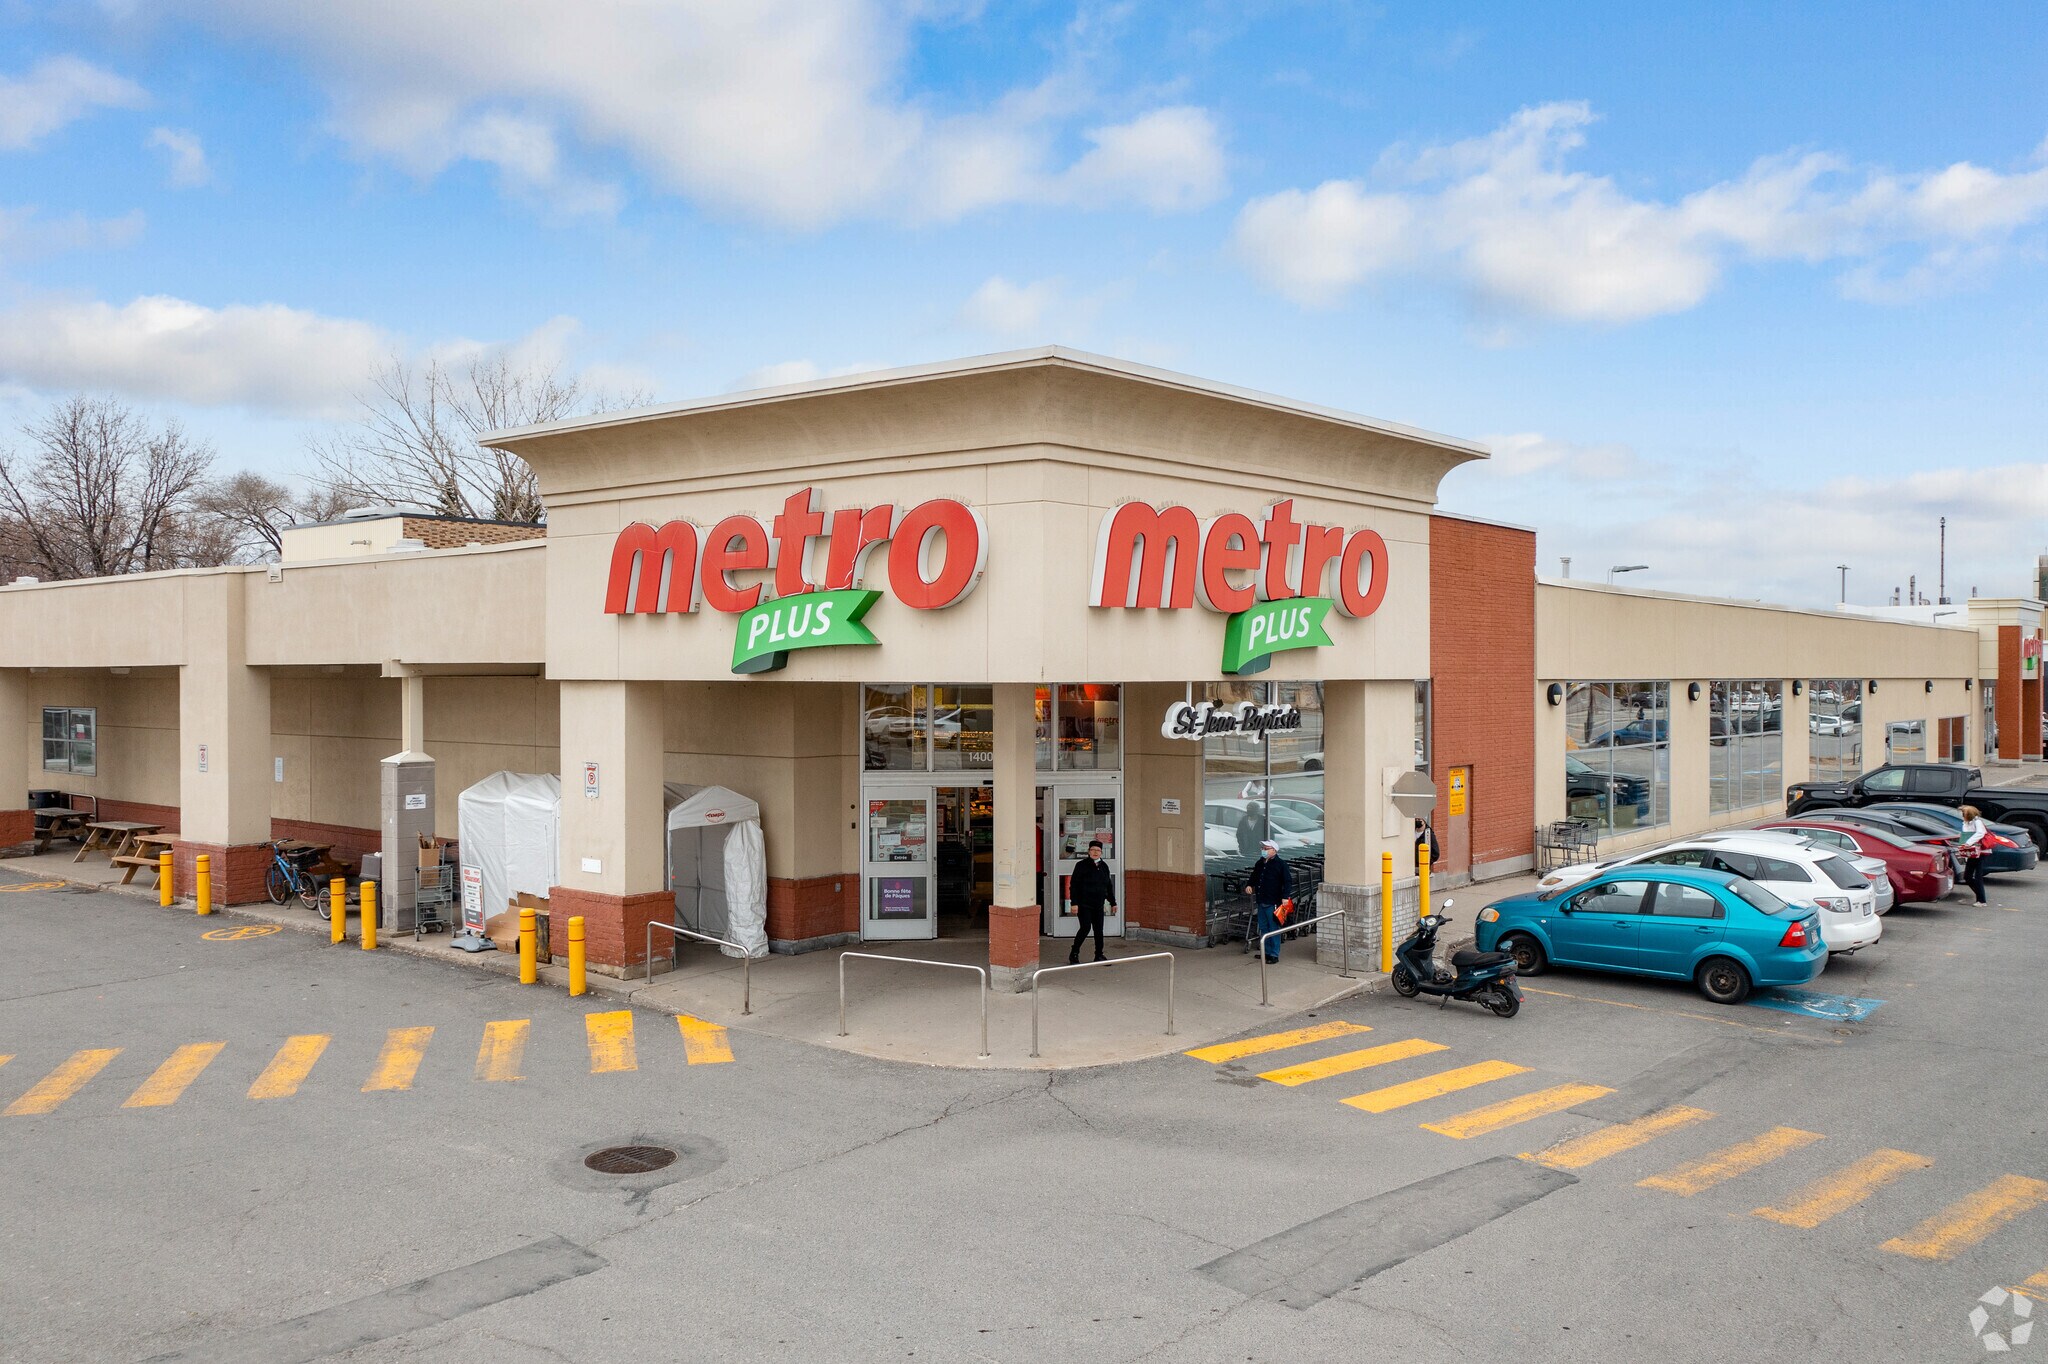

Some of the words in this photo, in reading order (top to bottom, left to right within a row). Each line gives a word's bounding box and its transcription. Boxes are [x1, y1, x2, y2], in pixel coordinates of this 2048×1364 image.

[604, 487, 988, 614] metro
[1089, 499, 1388, 617] metro
[747, 601, 833, 650] PLUS
[1248, 607, 1311, 651] PLUS
[968, 751, 993, 762] 1400
